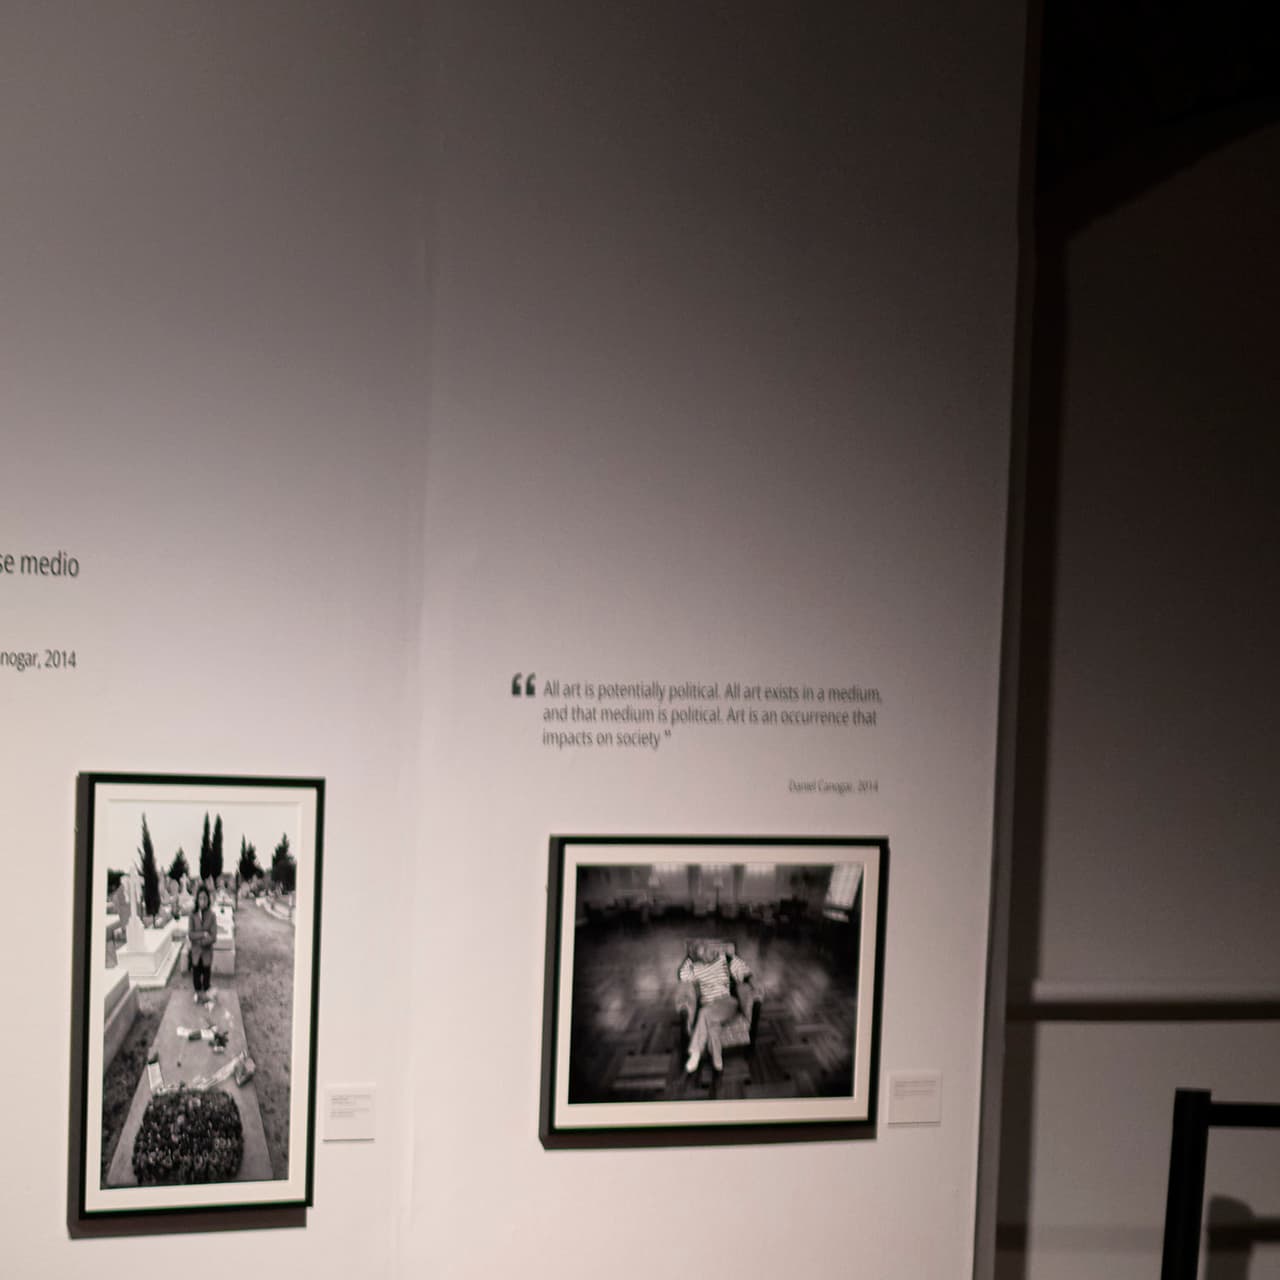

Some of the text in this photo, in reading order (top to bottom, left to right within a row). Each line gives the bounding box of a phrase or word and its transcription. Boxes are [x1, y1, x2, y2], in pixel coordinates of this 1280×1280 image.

[21, 551, 79, 577] medio
[45, 650, 76, 668] 2014
[544, 680, 559, 697] All
[563, 683, 581, 698] art
[585, 684, 594, 699] is
[598, 682, 665, 702] potentially
[725, 683, 740, 700] All
[744, 686, 761, 700] art
[765, 687, 799, 702] exists
[803, 688, 814, 701] in
[817, 688, 824, 702] a
[543, 705, 568, 722] and
[572, 705, 596, 722] that
[601, 705, 654, 723] medium
[658, 709, 667, 723] is
[726, 707, 744, 723] Art
[749, 710, 758, 723] is
[761, 711, 777, 724] an
[781, 711, 849, 726] occurrence
[853, 710, 876, 726] that
[543, 729, 593, 749] impacts
[597, 733, 613, 746] on
[617, 730, 660, 750] society
